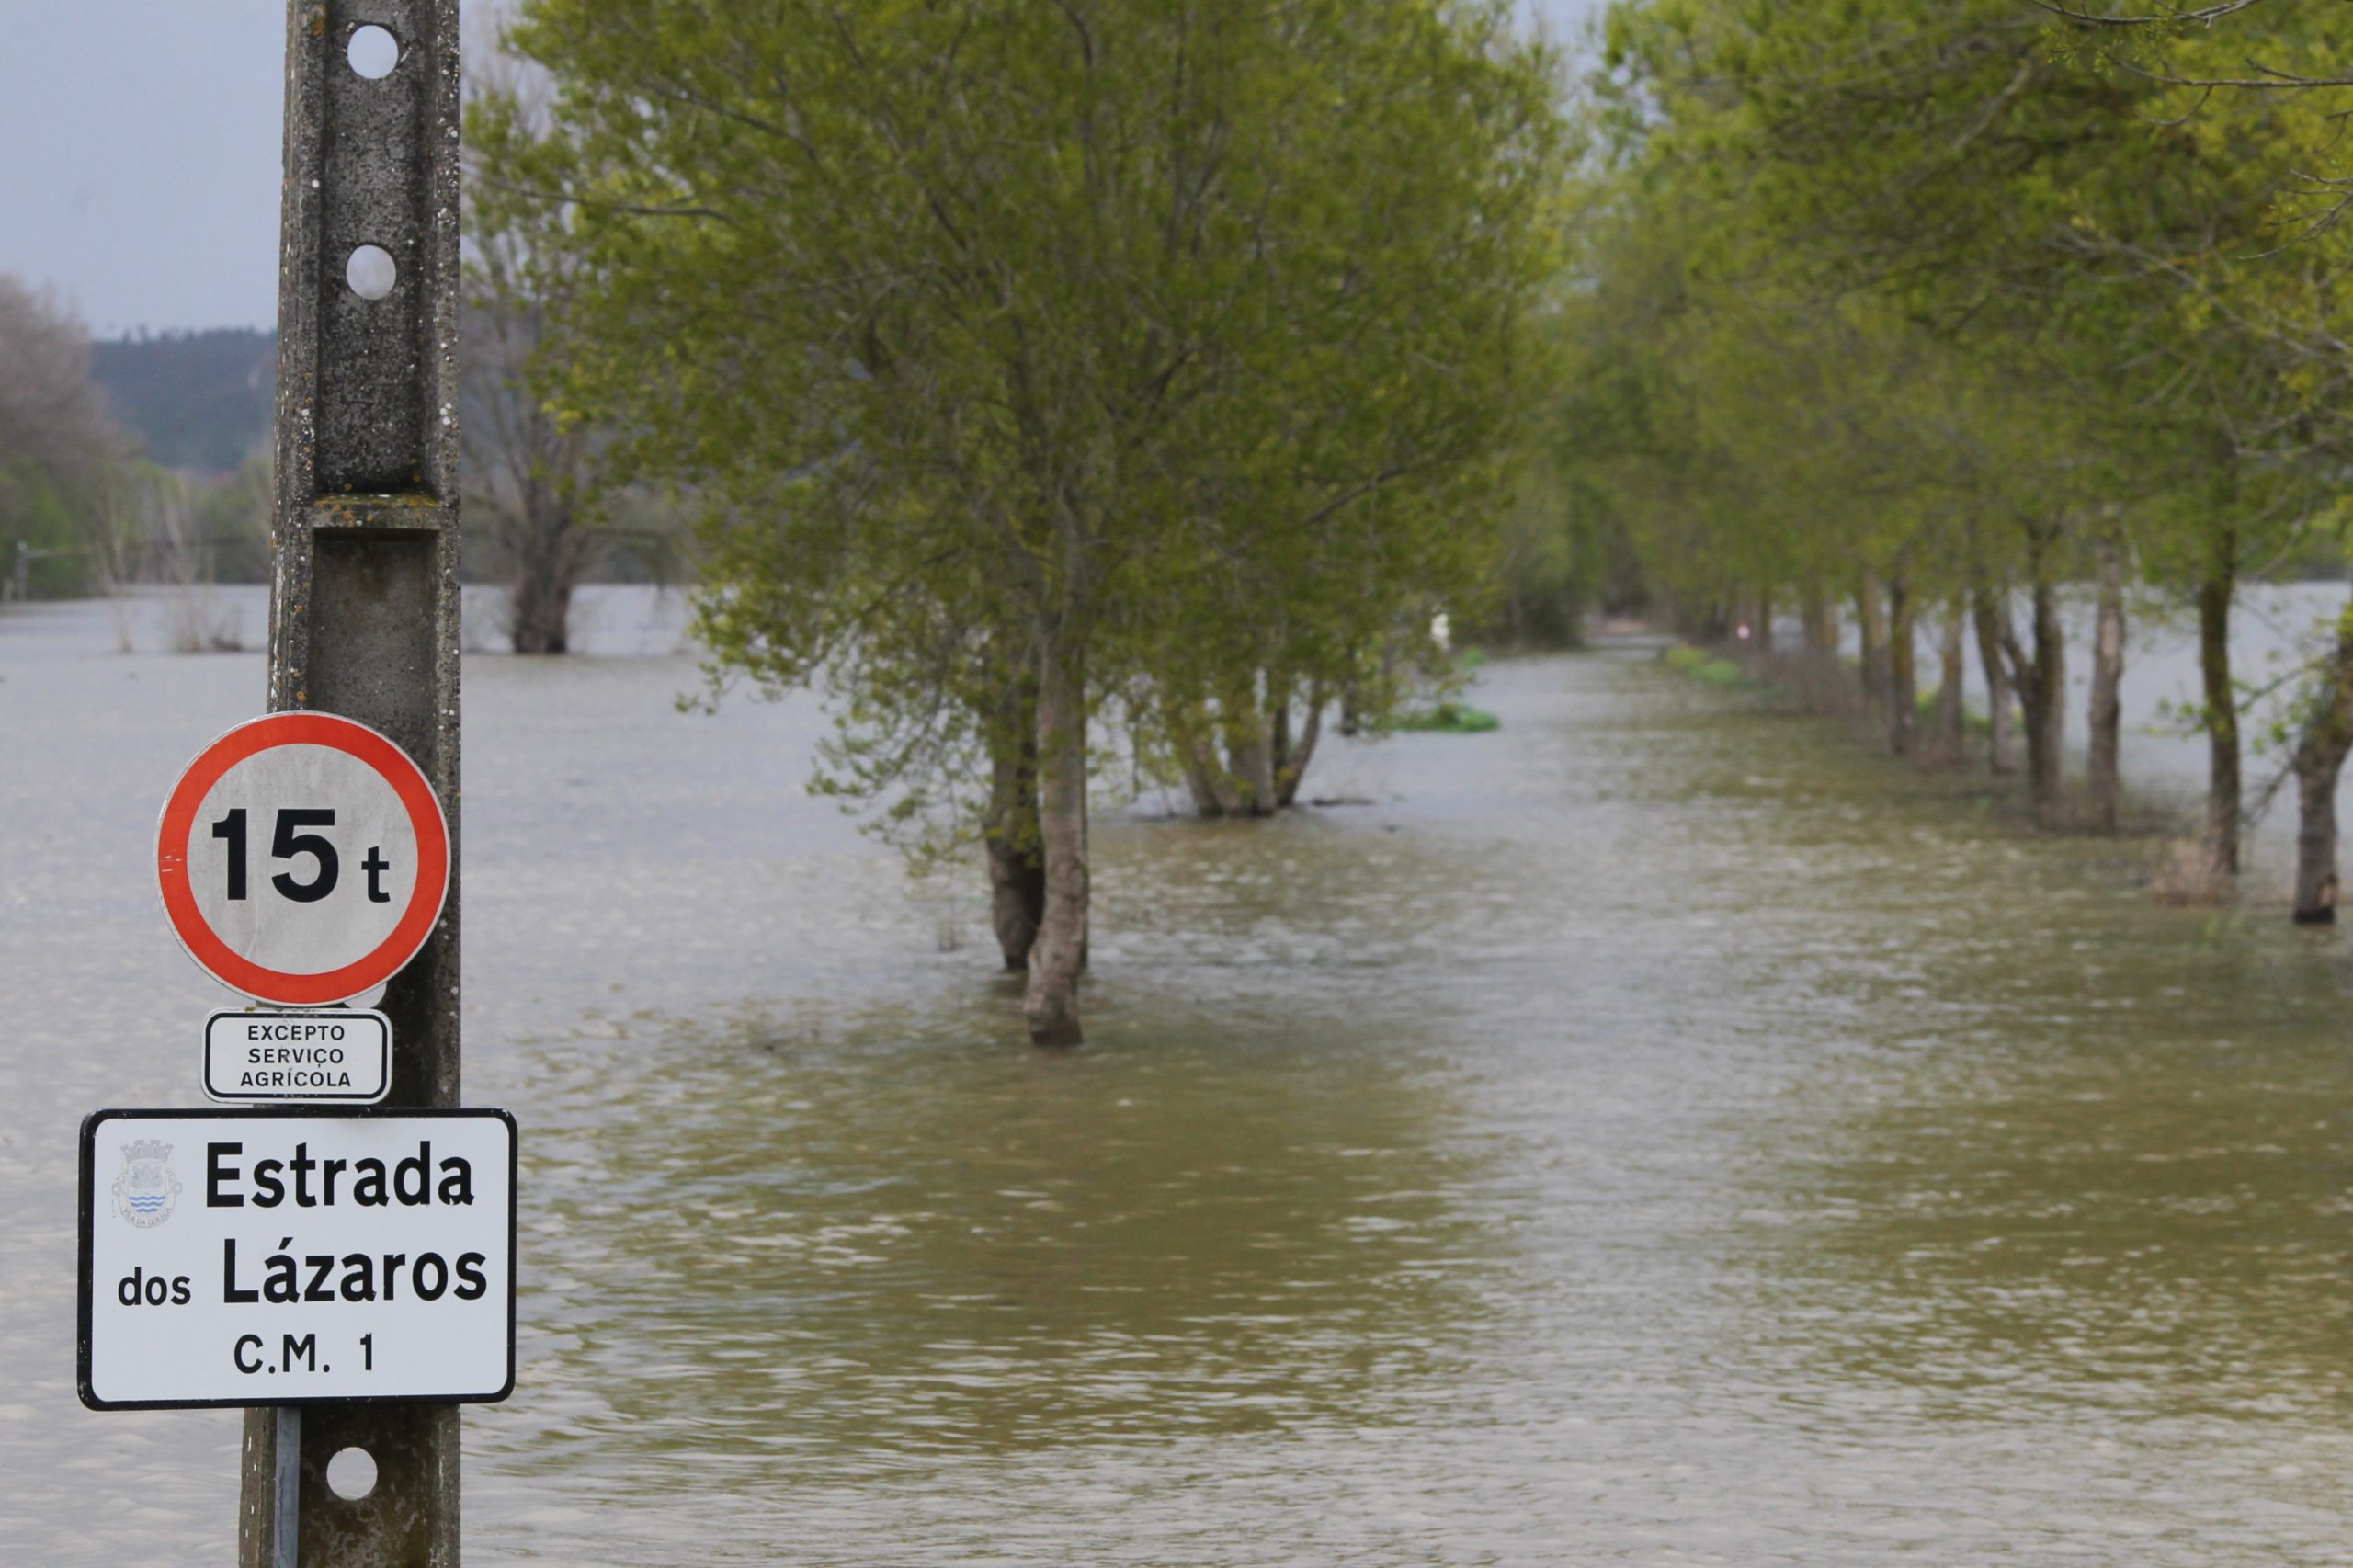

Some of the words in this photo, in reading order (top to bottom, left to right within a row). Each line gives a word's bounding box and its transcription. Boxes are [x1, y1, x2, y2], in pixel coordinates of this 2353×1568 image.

[212, 809, 339, 903] 15
[361, 846, 391, 903] t
[247, 1025, 345, 1041] EXCEPTO
[240, 1067, 351, 1087] AGRÍCOLA
[247, 1048, 344, 1068] SERVIÇO
[206, 1141, 475, 1209] Estrada
[119, 1267, 191, 1307] dos
[223, 1236, 487, 1304] Lázaros
[233, 1333, 330, 1374] C.M.
[359, 1333, 372, 1371] 1
